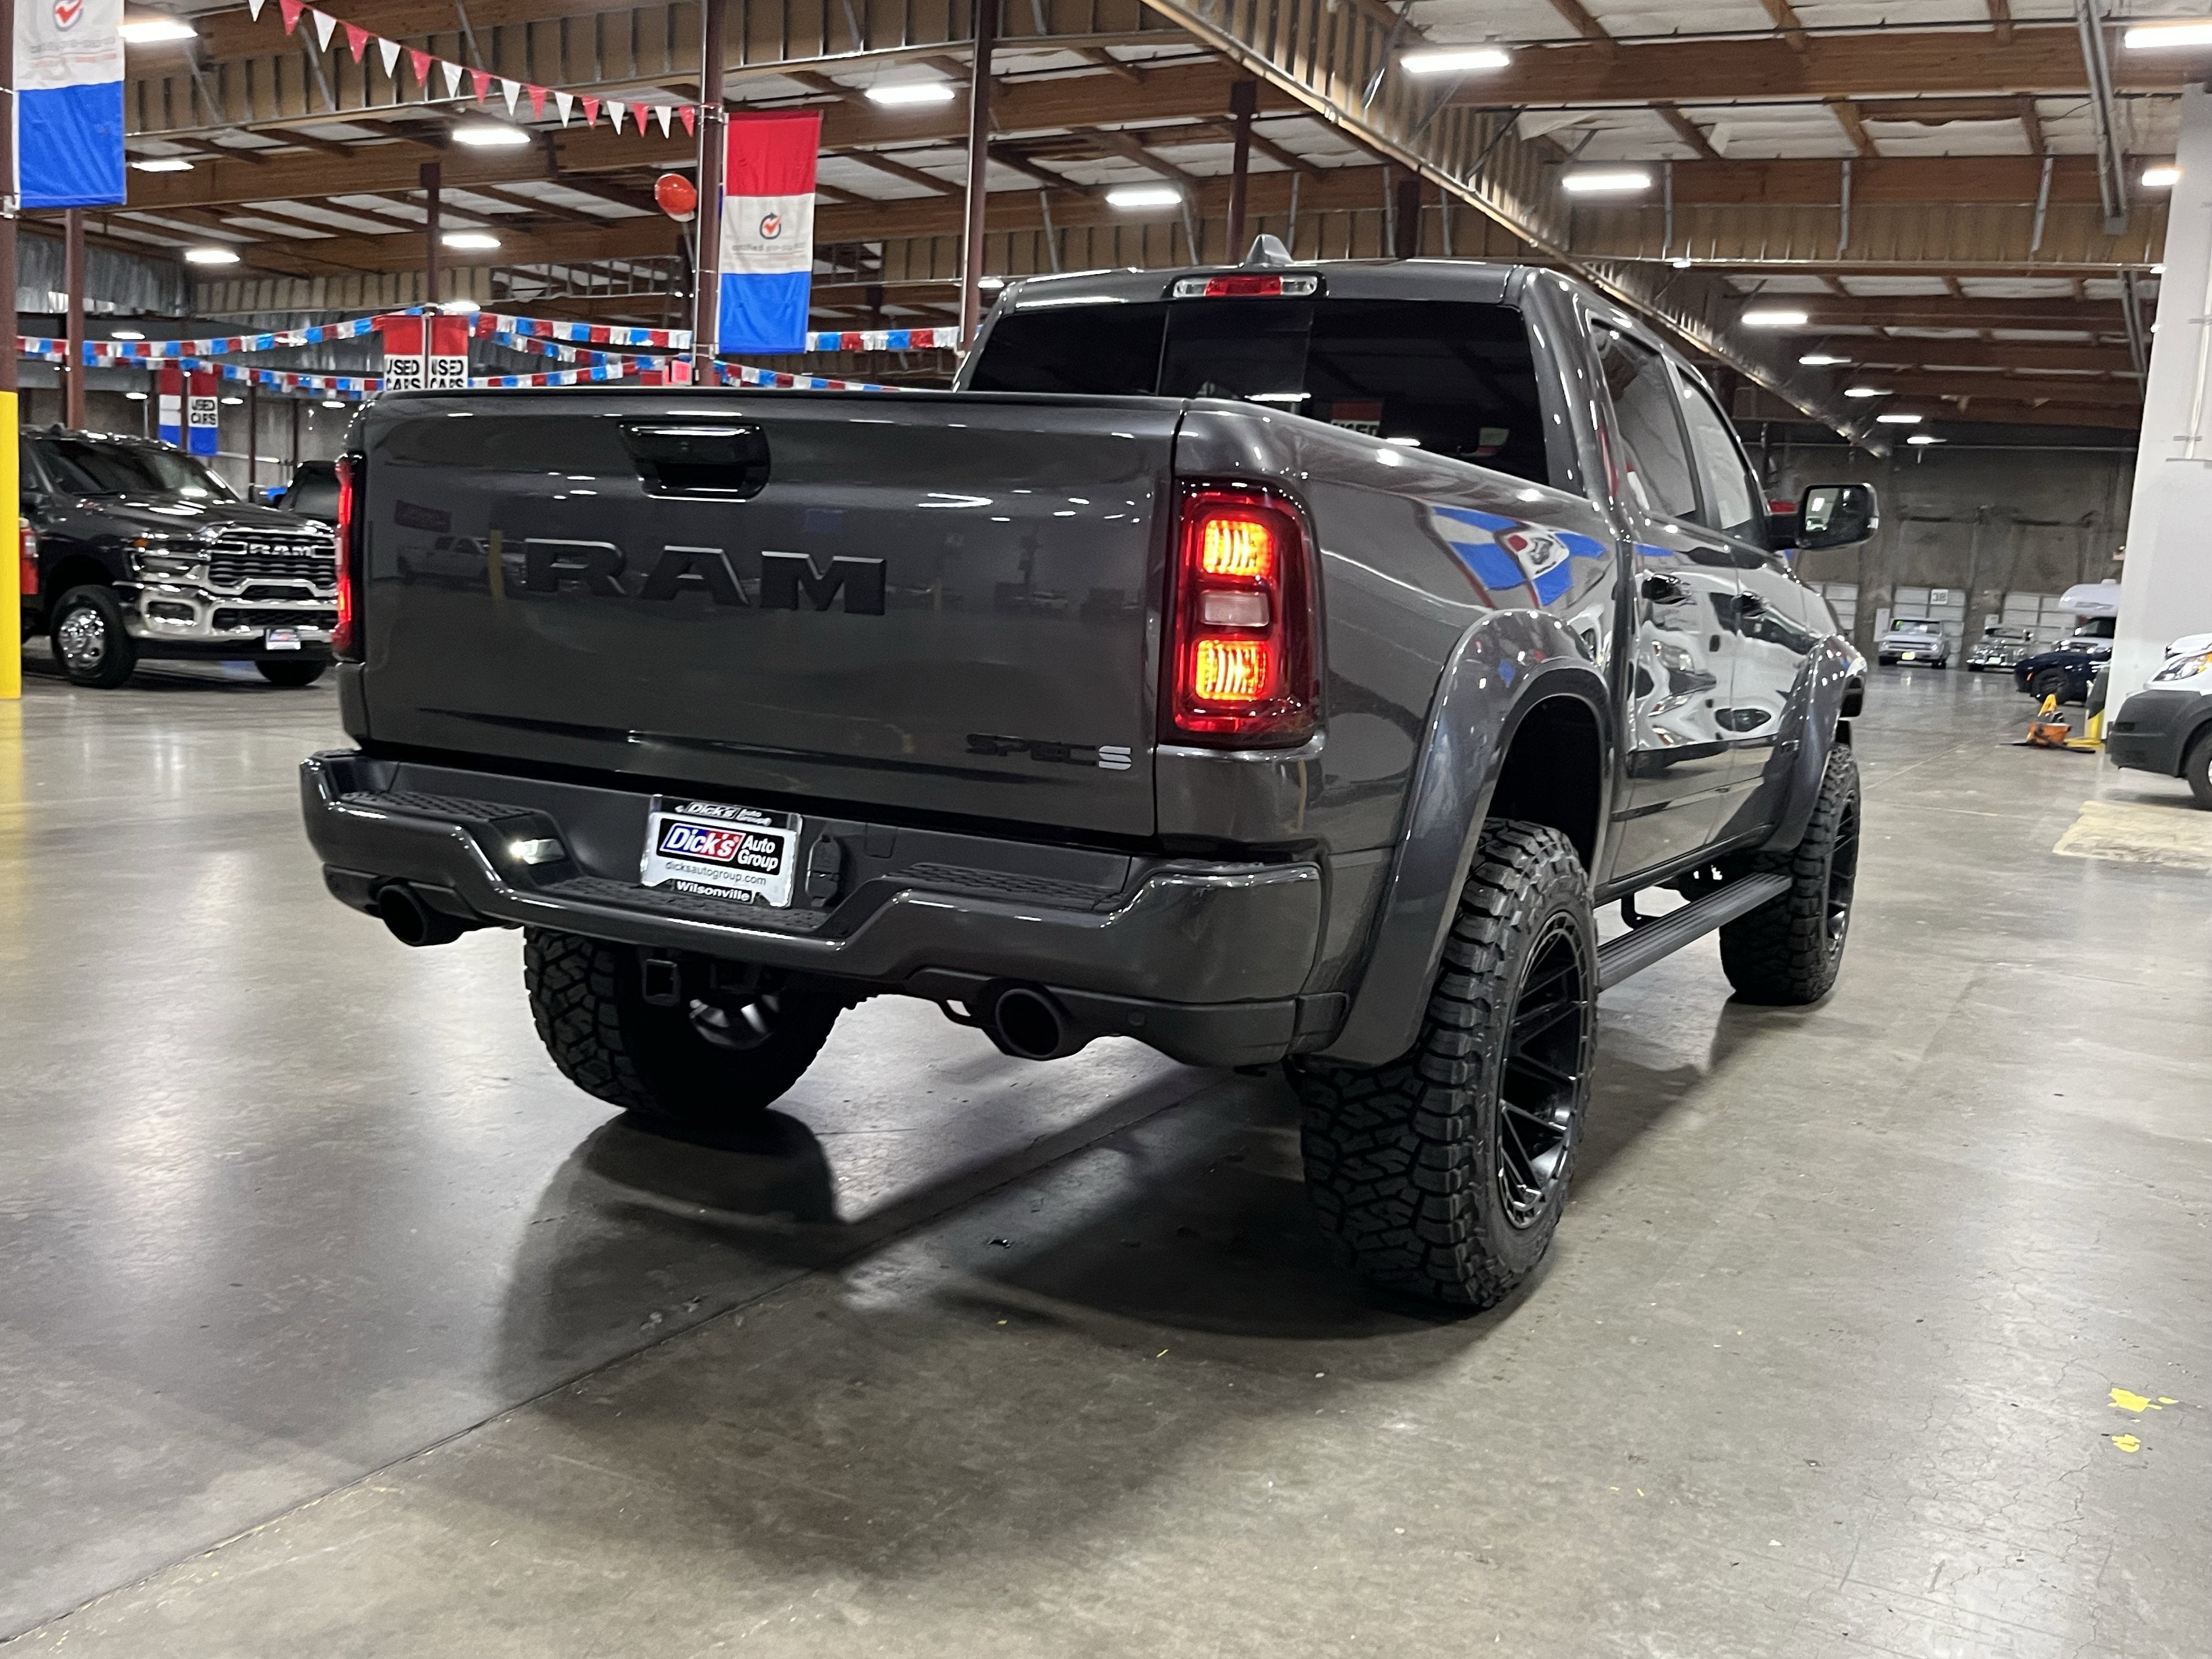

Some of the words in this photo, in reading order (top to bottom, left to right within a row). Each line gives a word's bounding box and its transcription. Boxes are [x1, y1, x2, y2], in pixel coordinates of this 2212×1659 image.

[250, 544, 311, 556] RAM
[525, 538, 885, 616] RAM
[666, 827, 736, 857] Dick's
[742, 835, 775, 854] Auto
[737, 849, 778, 871] Group
[665, 860, 766, 885] dicksautogroup.com
[676, 880, 751, 901] Wilsonville
